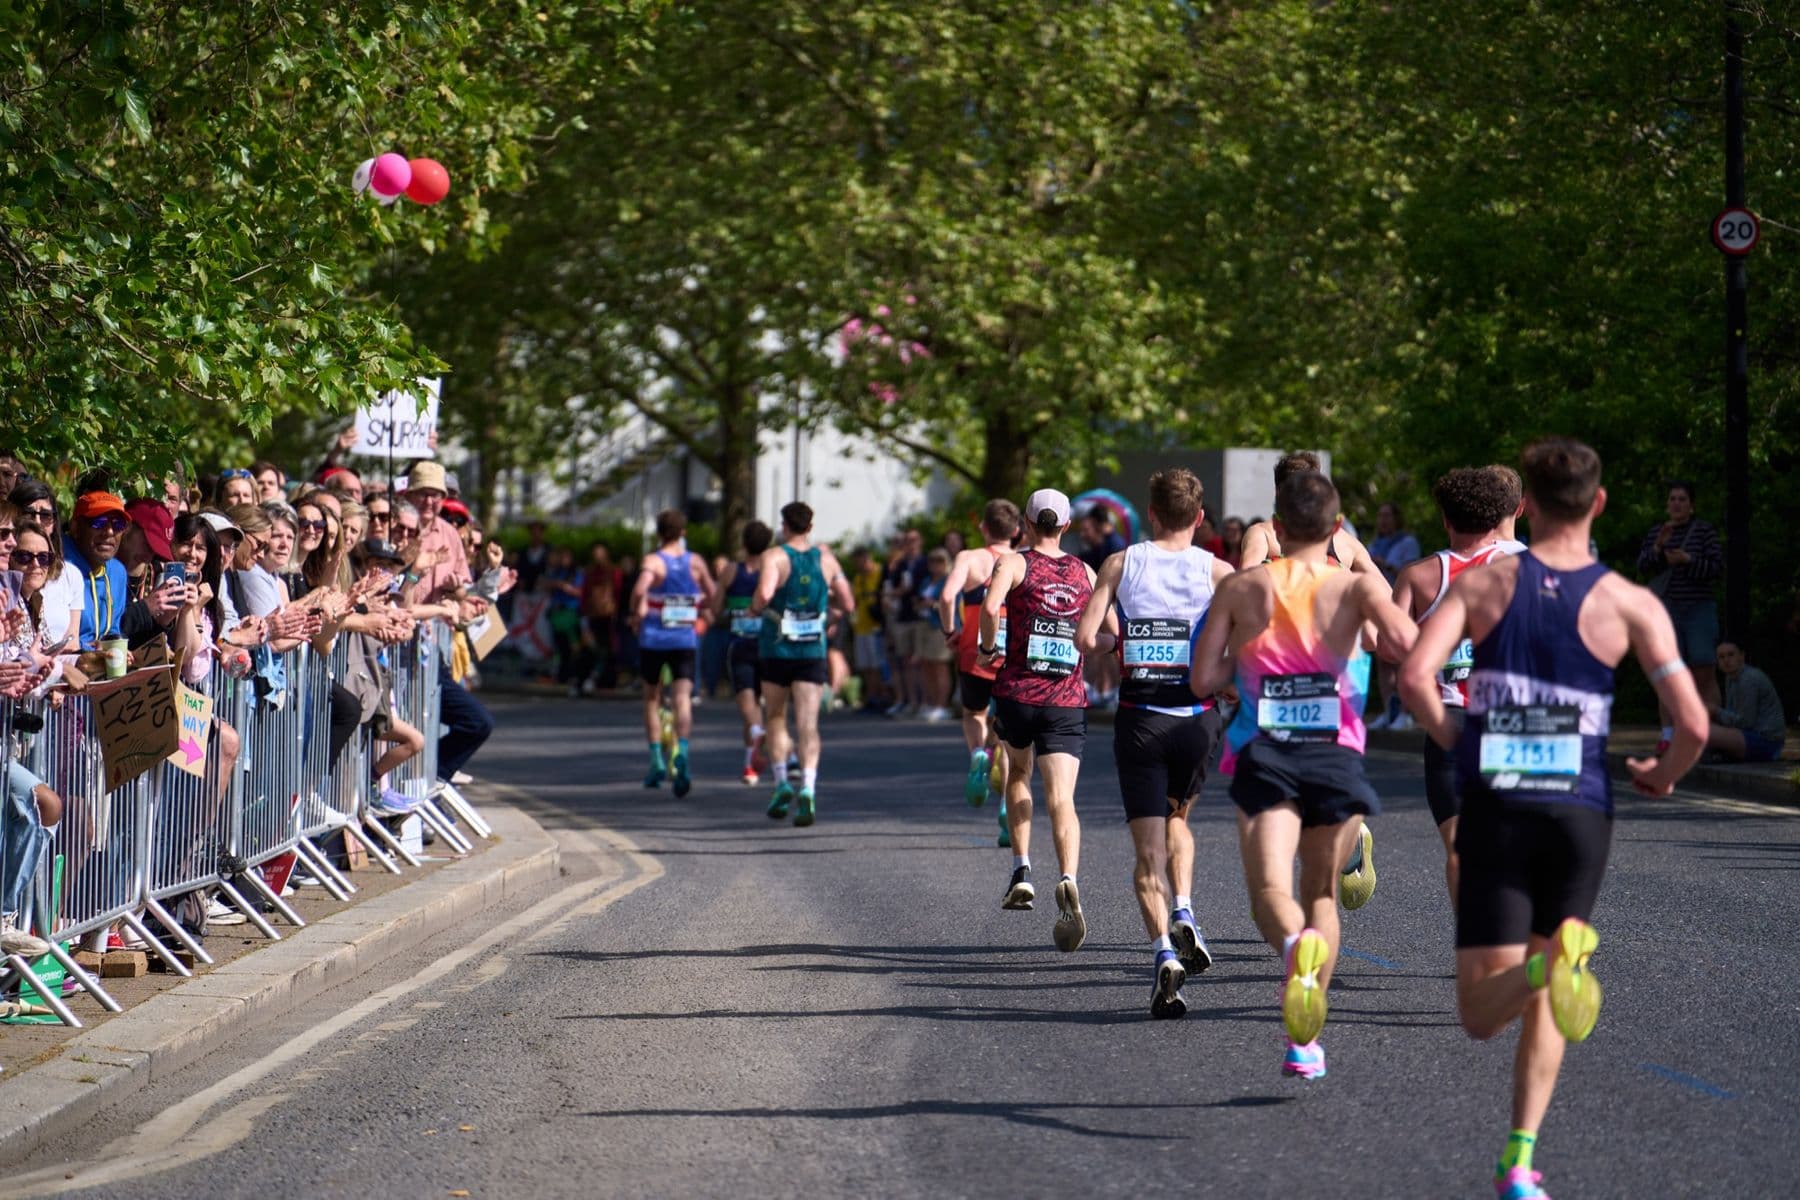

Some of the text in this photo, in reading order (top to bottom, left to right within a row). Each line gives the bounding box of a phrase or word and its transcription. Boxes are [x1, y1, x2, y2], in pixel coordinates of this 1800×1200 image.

[1720, 220, 1753, 240] 20
[1034, 618, 1055, 634] tcs
[1127, 622, 1151, 637] tcs
[1042, 640, 1072, 658] 1204
[1138, 645, 1174, 661] 1255
[1264, 679, 1293, 697] tcs
[183, 693, 204, 713] THAT
[1277, 703, 1322, 722] 2102
[182, 713, 207, 737] WAY
[1504, 742, 1555, 764] 2151
